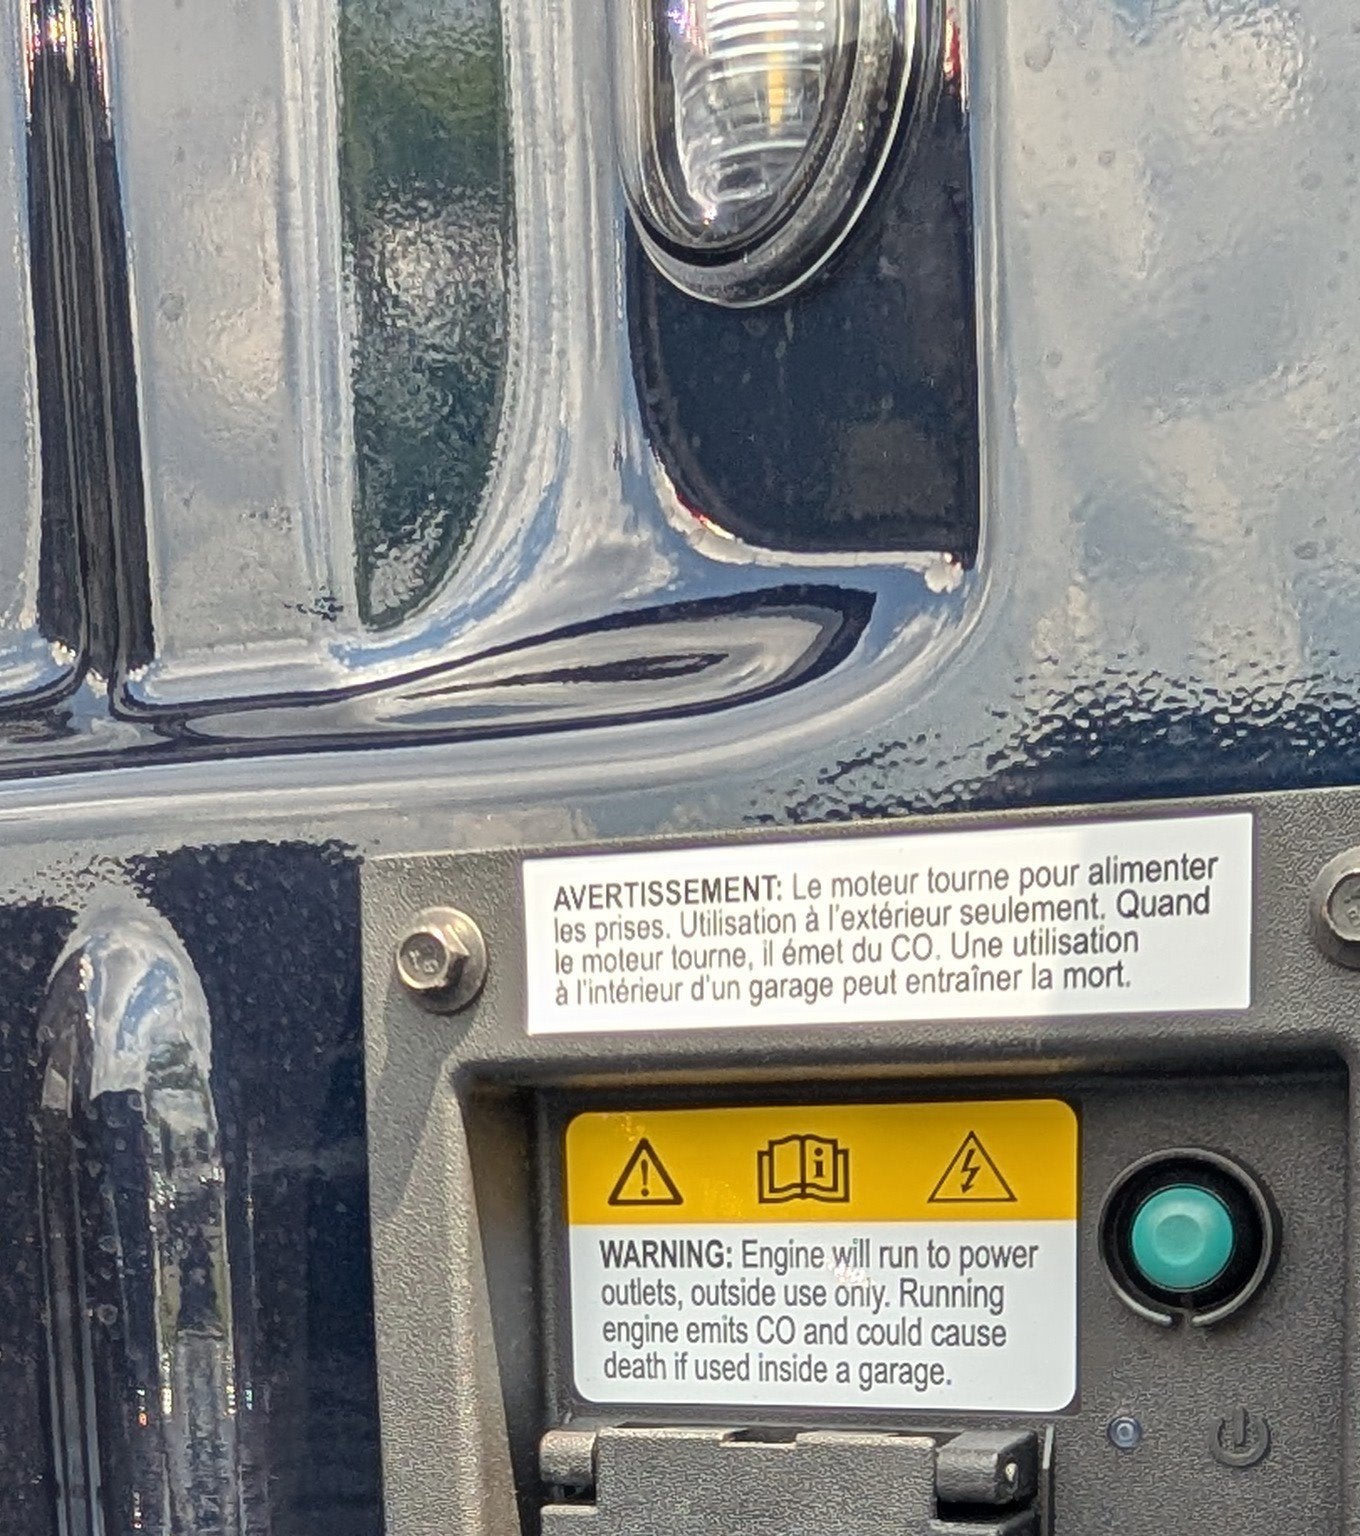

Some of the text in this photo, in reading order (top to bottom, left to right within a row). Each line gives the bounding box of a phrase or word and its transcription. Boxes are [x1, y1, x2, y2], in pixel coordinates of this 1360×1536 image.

[554, 853, 1219, 912] AVERTISSEMENT: Le moteur tourne pour alimenter
[554, 886, 1210, 948] les prises. Utilisation à l'extérieur seulement. Quand
[556, 925, 1138, 974] le moteur tourne, il émet du CO. Une utilisation
[556, 960, 1130, 1007] à l'intérieur d'un garage peut entraîner la mort.
[599, 1238, 1039, 1276] WARNING: Engine will run to power
[602, 1277, 1004, 1316] outlets, outside use only. Running
[603, 1314, 1006, 1350] engine emits CO and could cause
[604, 1351, 951, 1392] death if used inside a garage.
